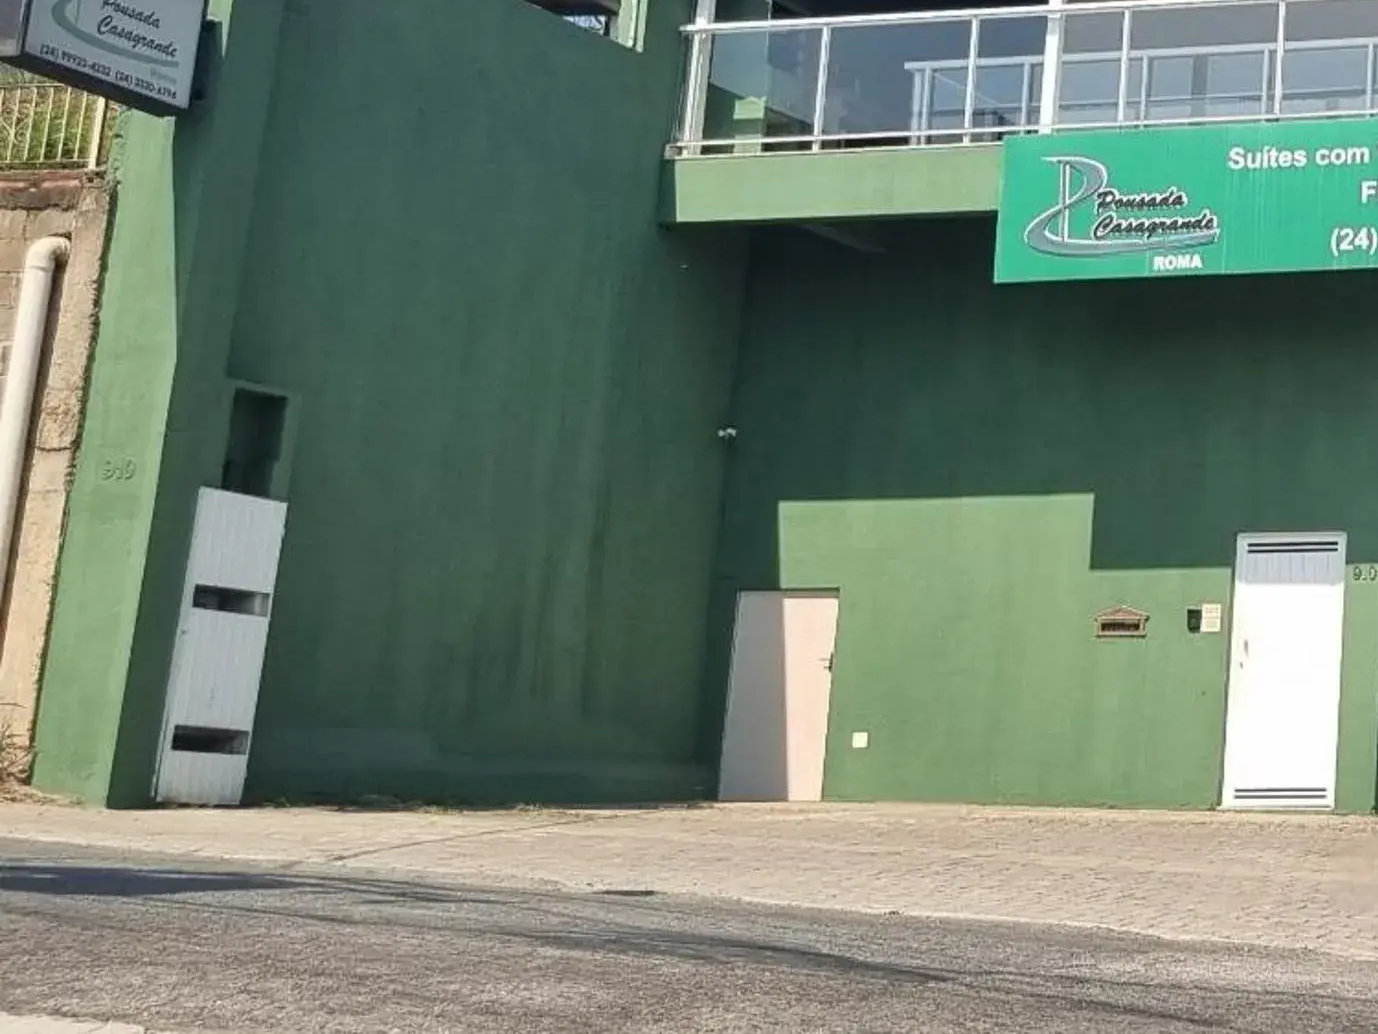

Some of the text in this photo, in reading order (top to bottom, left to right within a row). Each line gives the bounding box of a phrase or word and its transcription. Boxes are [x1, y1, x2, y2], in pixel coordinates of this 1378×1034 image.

[97, 15, 177, 57] Casagrande
[1316, 147, 1370, 166] com
[1096, 188, 1186, 213] Pousada
[1092, 211, 1216, 240] Casagrande
[1331, 227, 1378, 256] (24)
[1153, 253, 1203, 270] ROMA
